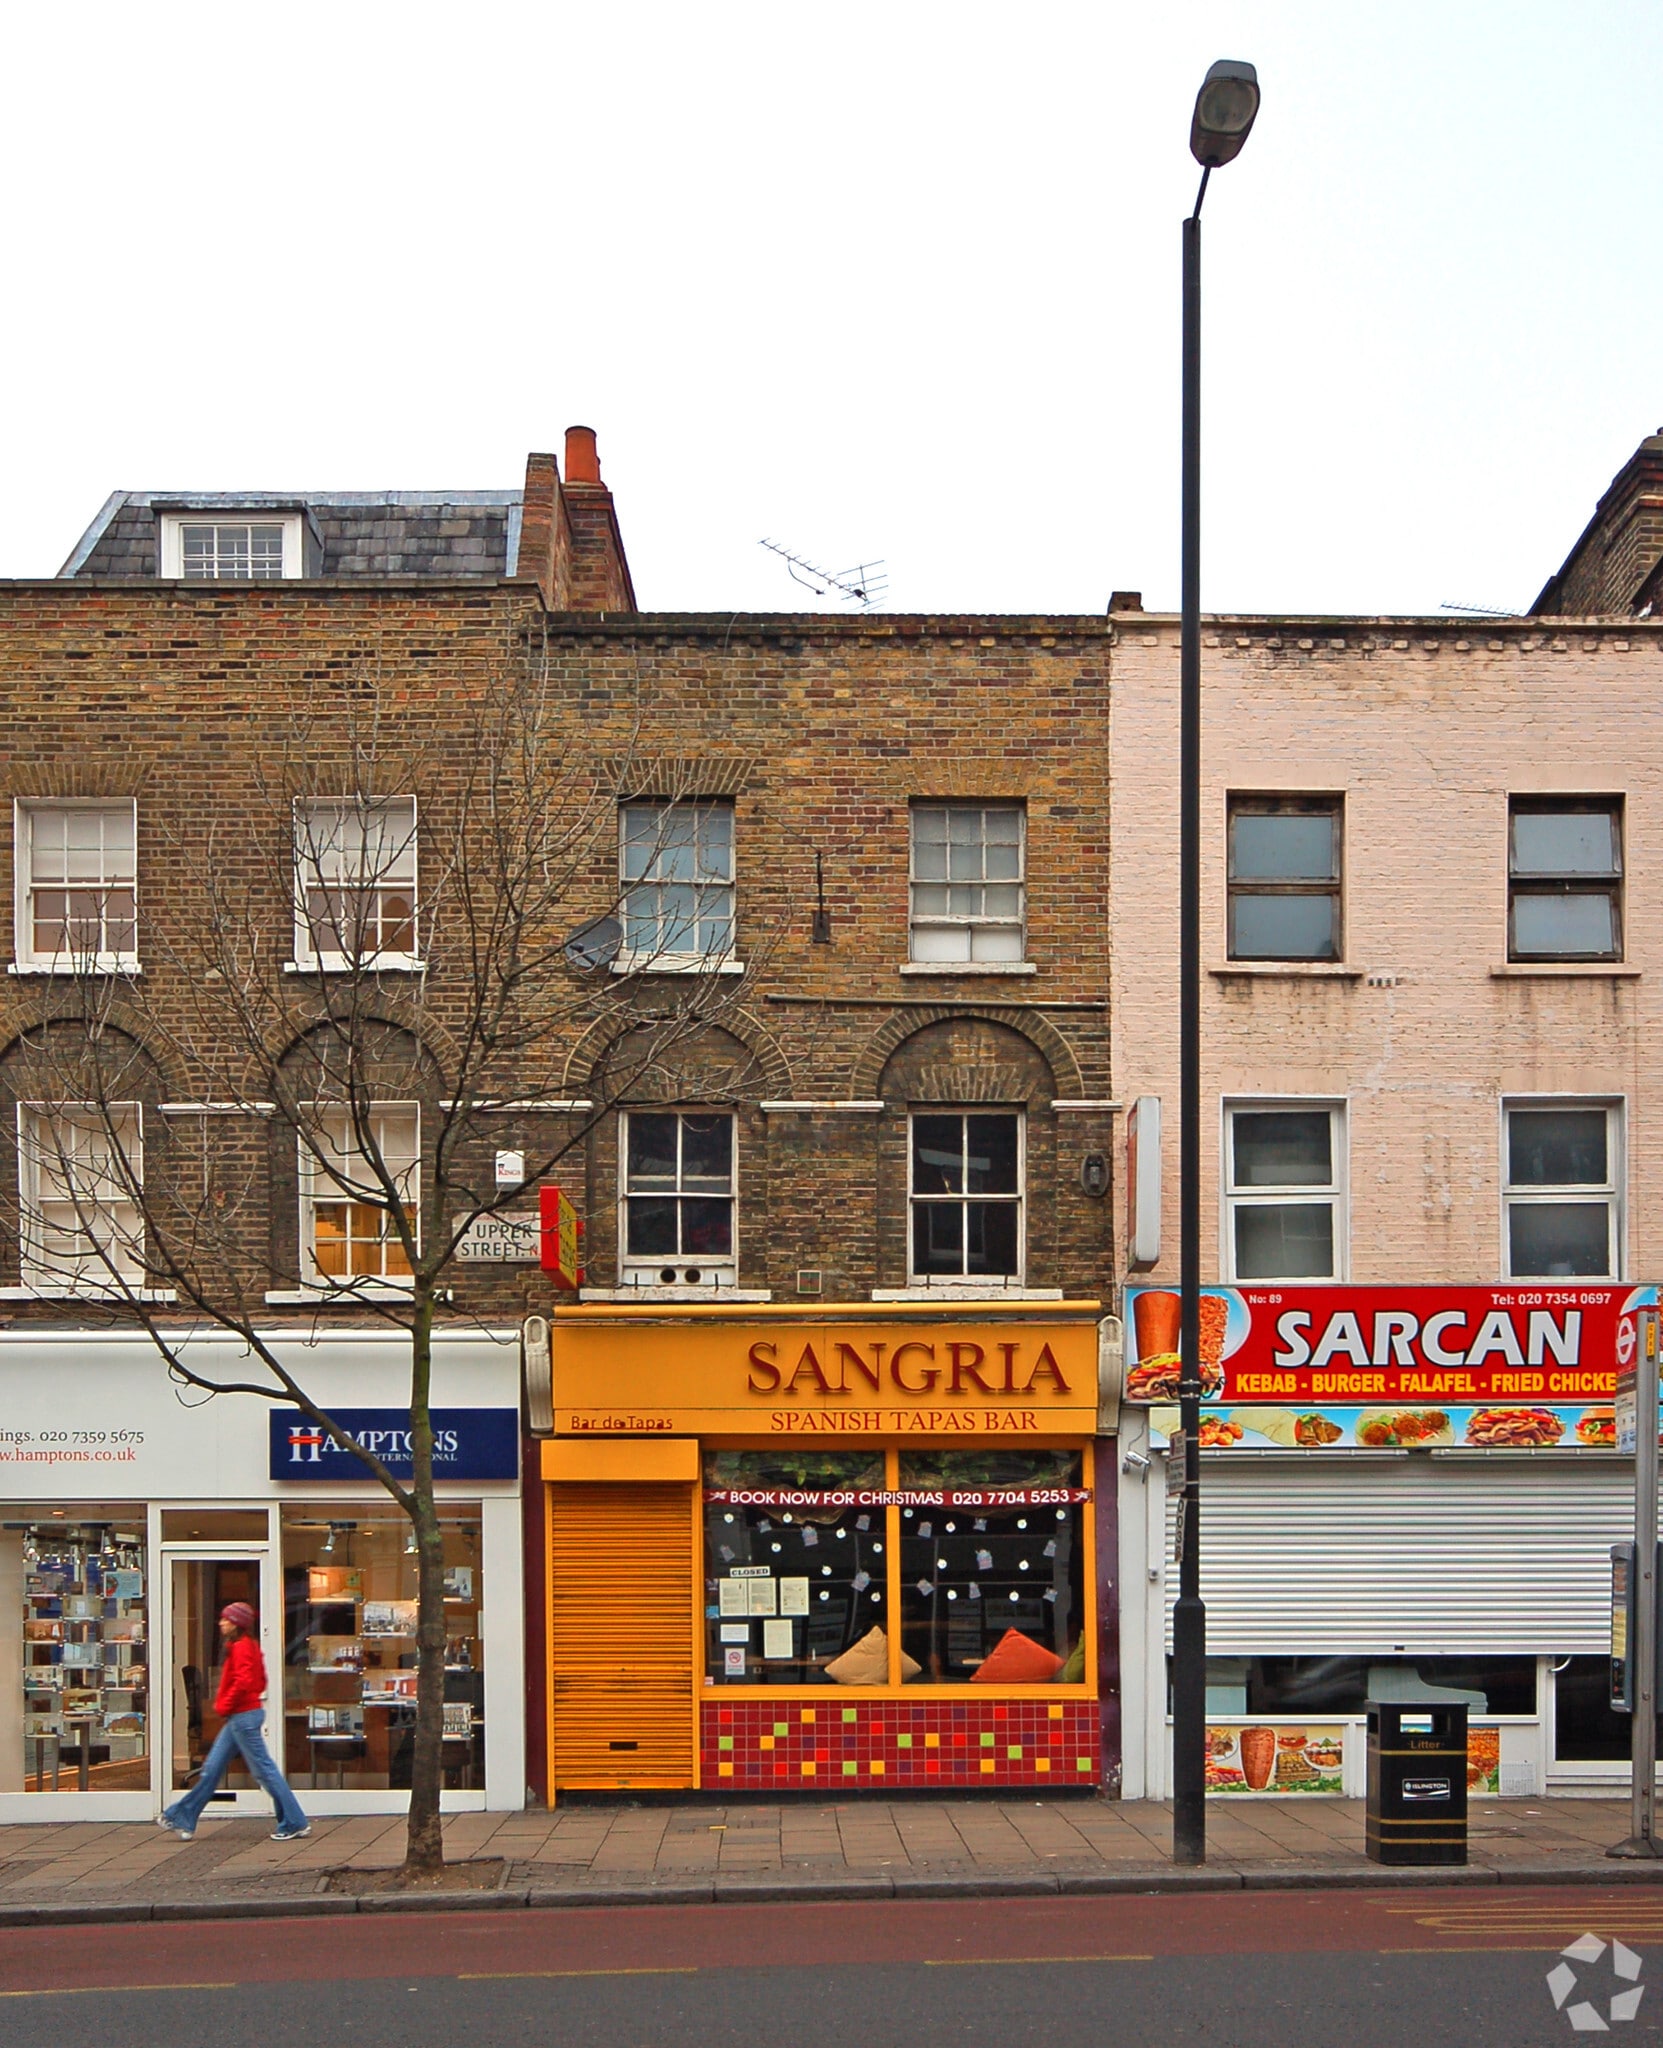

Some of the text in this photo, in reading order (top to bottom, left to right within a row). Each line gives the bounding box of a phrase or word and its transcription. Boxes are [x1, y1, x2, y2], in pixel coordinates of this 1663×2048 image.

[476, 1224, 533, 1239] UPPER
[1249, 1294, 1282, 1304] No: 89
[1491, 1293, 1611, 1305] Tel: 020 7354 0697
[1273, 1310, 1582, 1367] SARCAN
[747, 1341, 1072, 1392] SANGRIA
[1236, 1373, 1297, 1393] KEBAB
[1312, 1373, 1386, 1393] BURGER
[1400, 1373, 1476, 1392] FALAFEL
[1491, 1373, 1545, 1392] FRIED
[1549, 1372, 1617, 1392] CHICKE
[571, 1415, 673, 1431] Bar de Tapas
[770, 1411, 1039, 1431] SPANISH TAPAS BAR
[39, 1431, 68, 1441] 020
[72, 1431, 106, 1444] 7359
[110, 1429, 144, 1444] 5675
[730, 1489, 1070, 1505] BOOK NOW FOR CHRISTMAS 020 7704 5253
[731, 1567, 769, 1576] CLOSED
[1410, 1740, 1440, 1749] Litter
